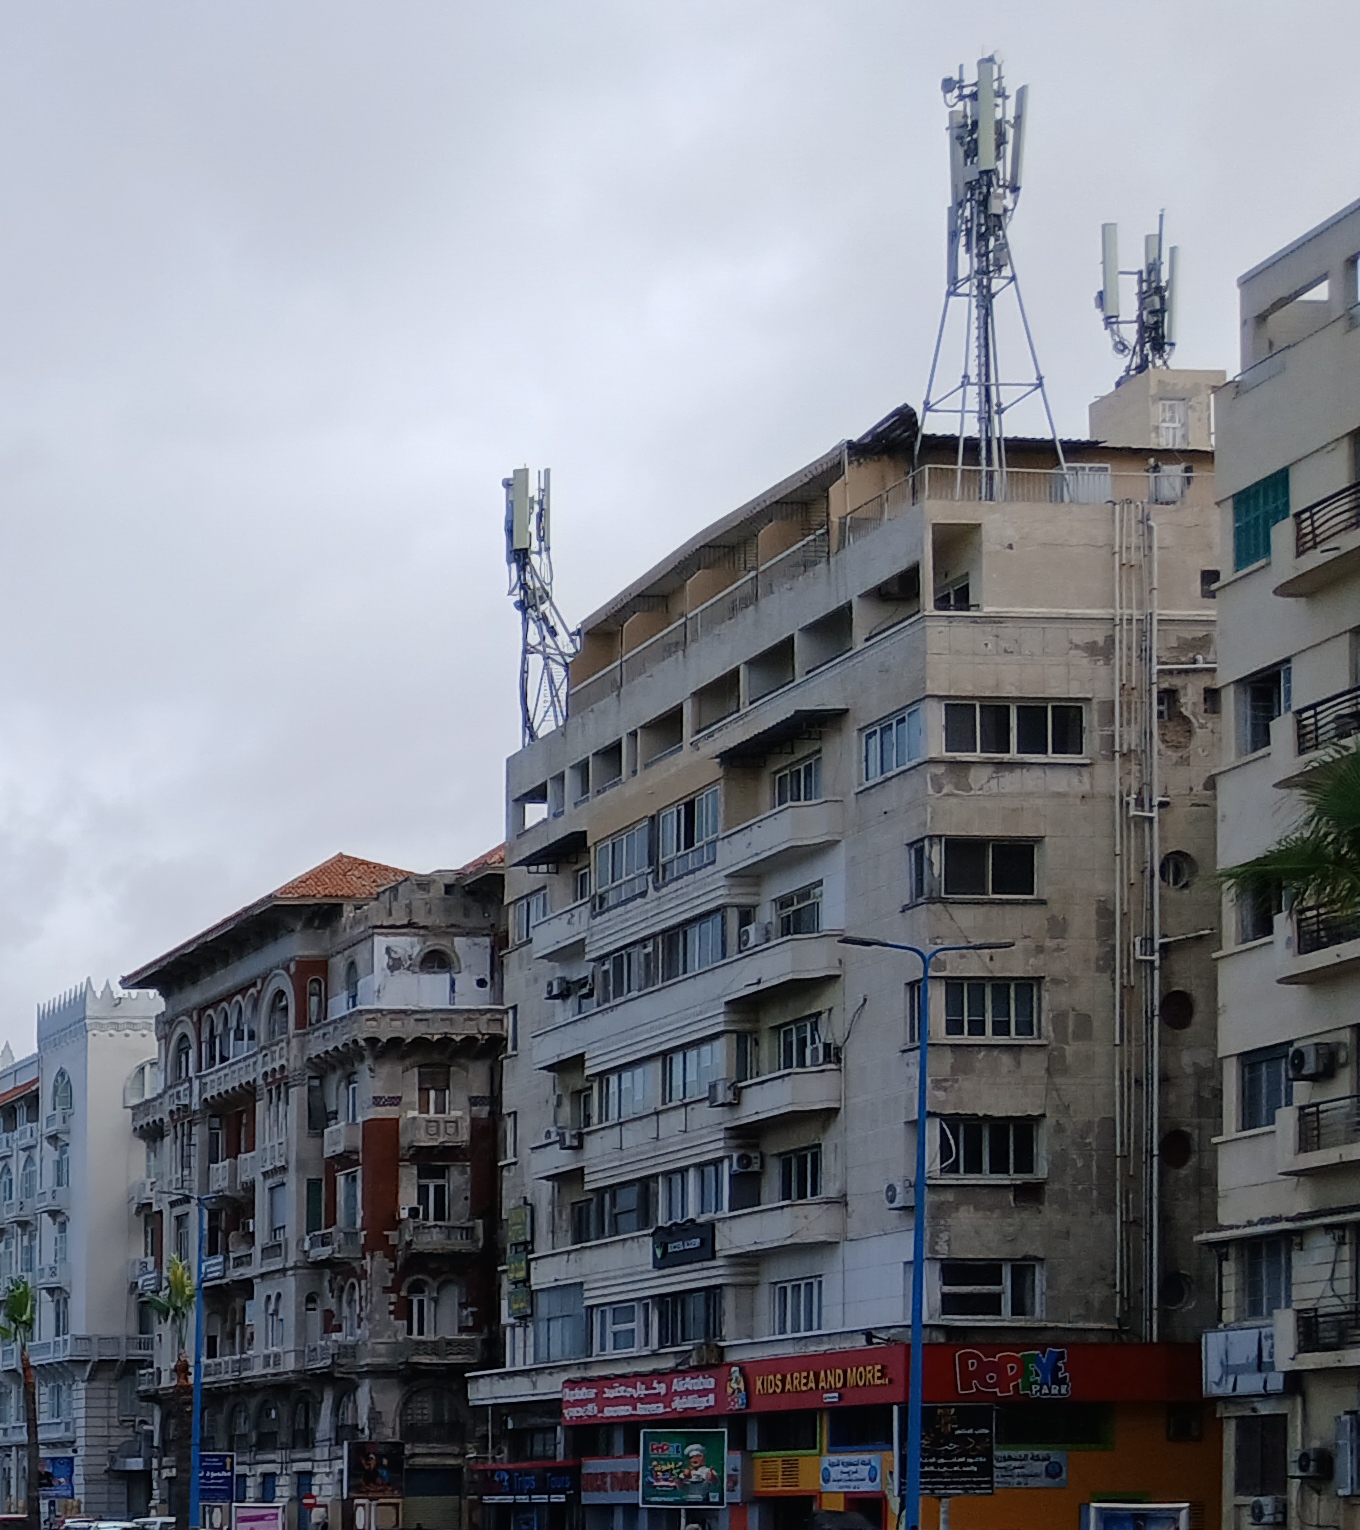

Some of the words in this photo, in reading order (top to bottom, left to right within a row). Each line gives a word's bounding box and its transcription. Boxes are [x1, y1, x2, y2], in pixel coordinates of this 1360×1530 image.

[755, 1373, 782, 1395] KIDS
[785, 1370, 816, 1392] AREA
[818, 1368, 844, 1389] AND
[1031, 1383, 1068, 1396] PARK
[513, 1472, 536, 1493] Trips
[547, 1473, 571, 1489] Tours
